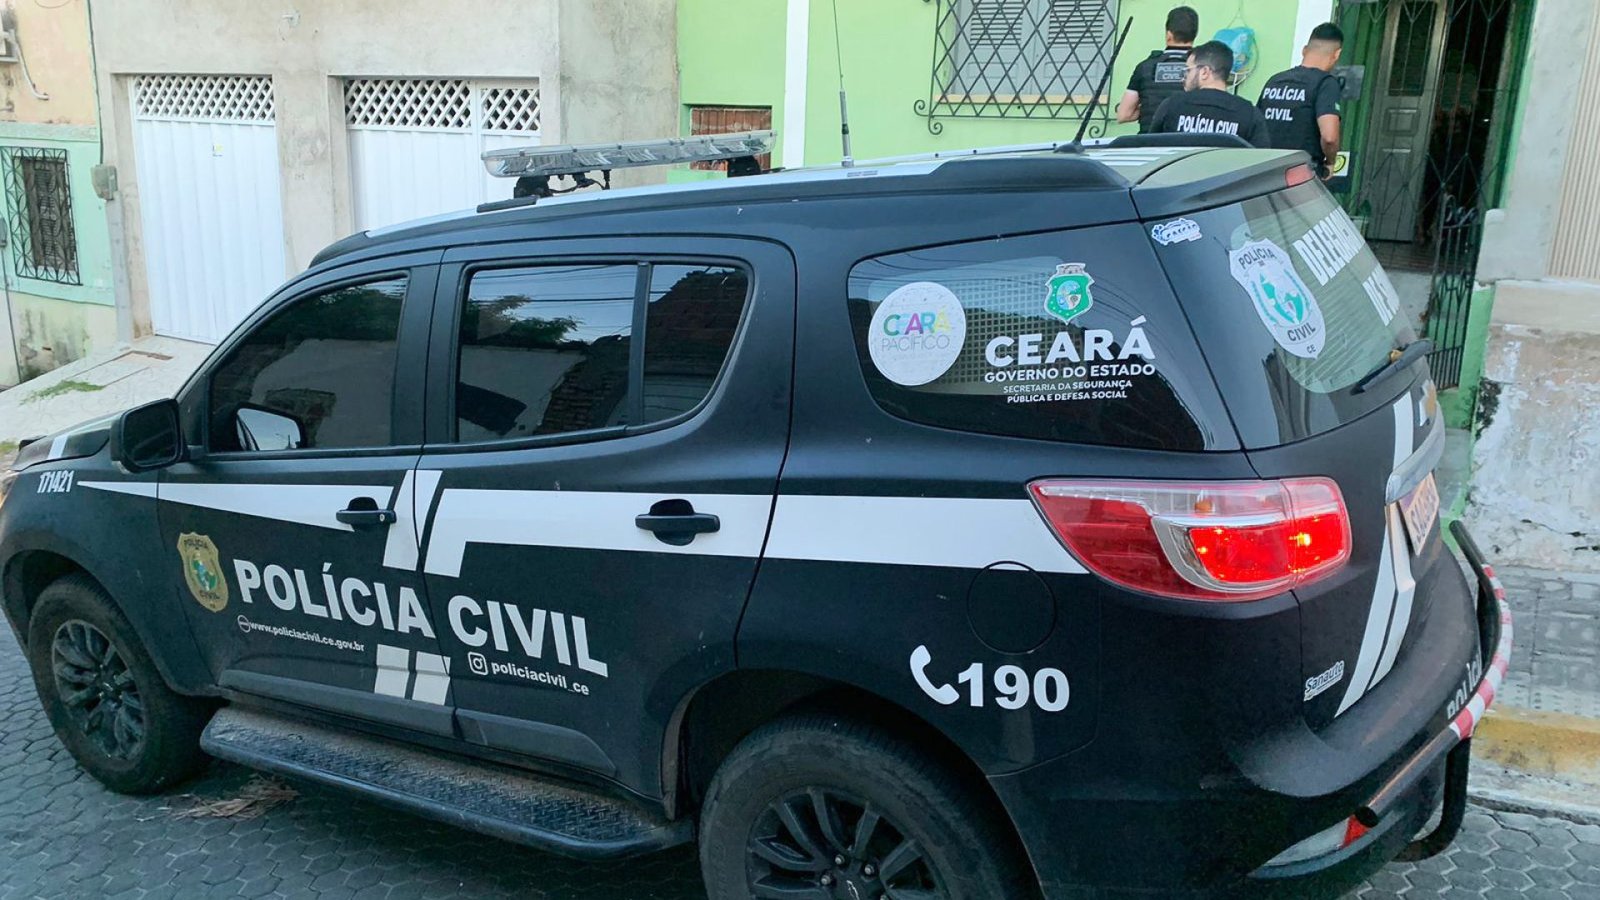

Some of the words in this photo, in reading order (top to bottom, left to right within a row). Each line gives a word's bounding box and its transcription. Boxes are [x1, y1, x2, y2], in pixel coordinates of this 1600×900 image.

[1262, 86, 1306, 101] POLÍCIA
[1264, 107, 1293, 121] CIVIL
[985, 315, 1156, 367] CEARÁ
[1287, 322, 1316, 342] CIVIL
[984, 369, 1059, 384] GOVERNO
[1063, 366, 1087, 378] DO
[1090, 363, 1156, 377] ESTADO
[1003, 384, 1057, 394] SECRETARIA
[1058, 382, 1071, 390] DA
[1072, 379, 1133, 391] SEGURANÇA
[1007, 393, 1046, 404] PÚBLICA
[1047, 393, 1053, 401] E
[1054, 392, 1090, 401] DEFESA
[1091, 390, 1128, 400] SOCIAL
[37, 470, 75, 494] 171421
[233, 558, 437, 639] POLÍCIA
[447, 594, 608, 678] CIVIL
[250, 621, 365, 652] www.policiacivil.ce.gov.br
[491, 661, 590, 696] policiacivil_ce
[958, 662, 1070, 712] 190
